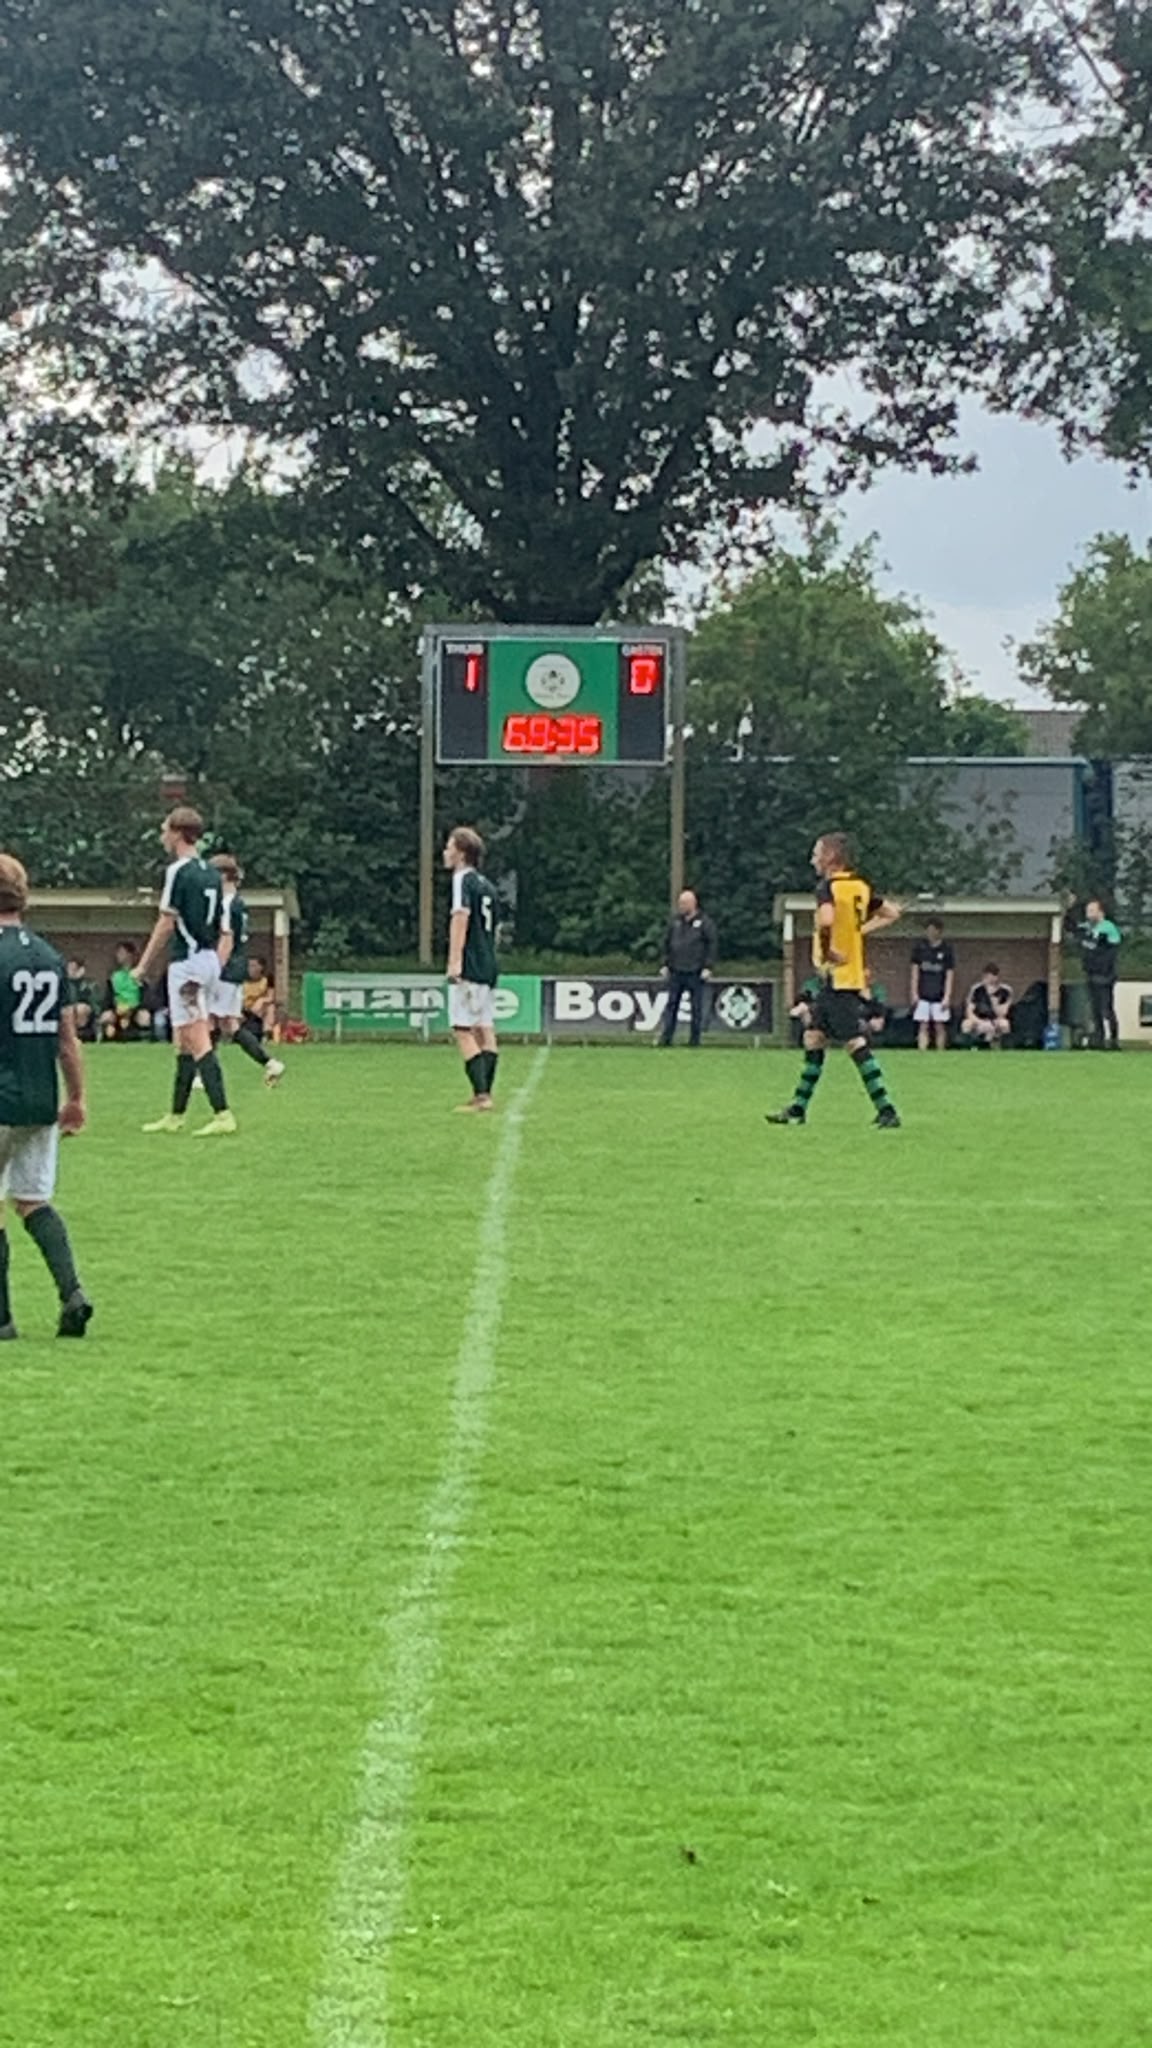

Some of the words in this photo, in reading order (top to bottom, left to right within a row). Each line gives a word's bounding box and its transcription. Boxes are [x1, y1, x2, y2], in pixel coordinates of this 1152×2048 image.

[466, 659, 476, 691] 1
[630, 659, 656, 694] 0
[204, 888, 217, 925] 7
[12, 969, 58, 1034] 22
